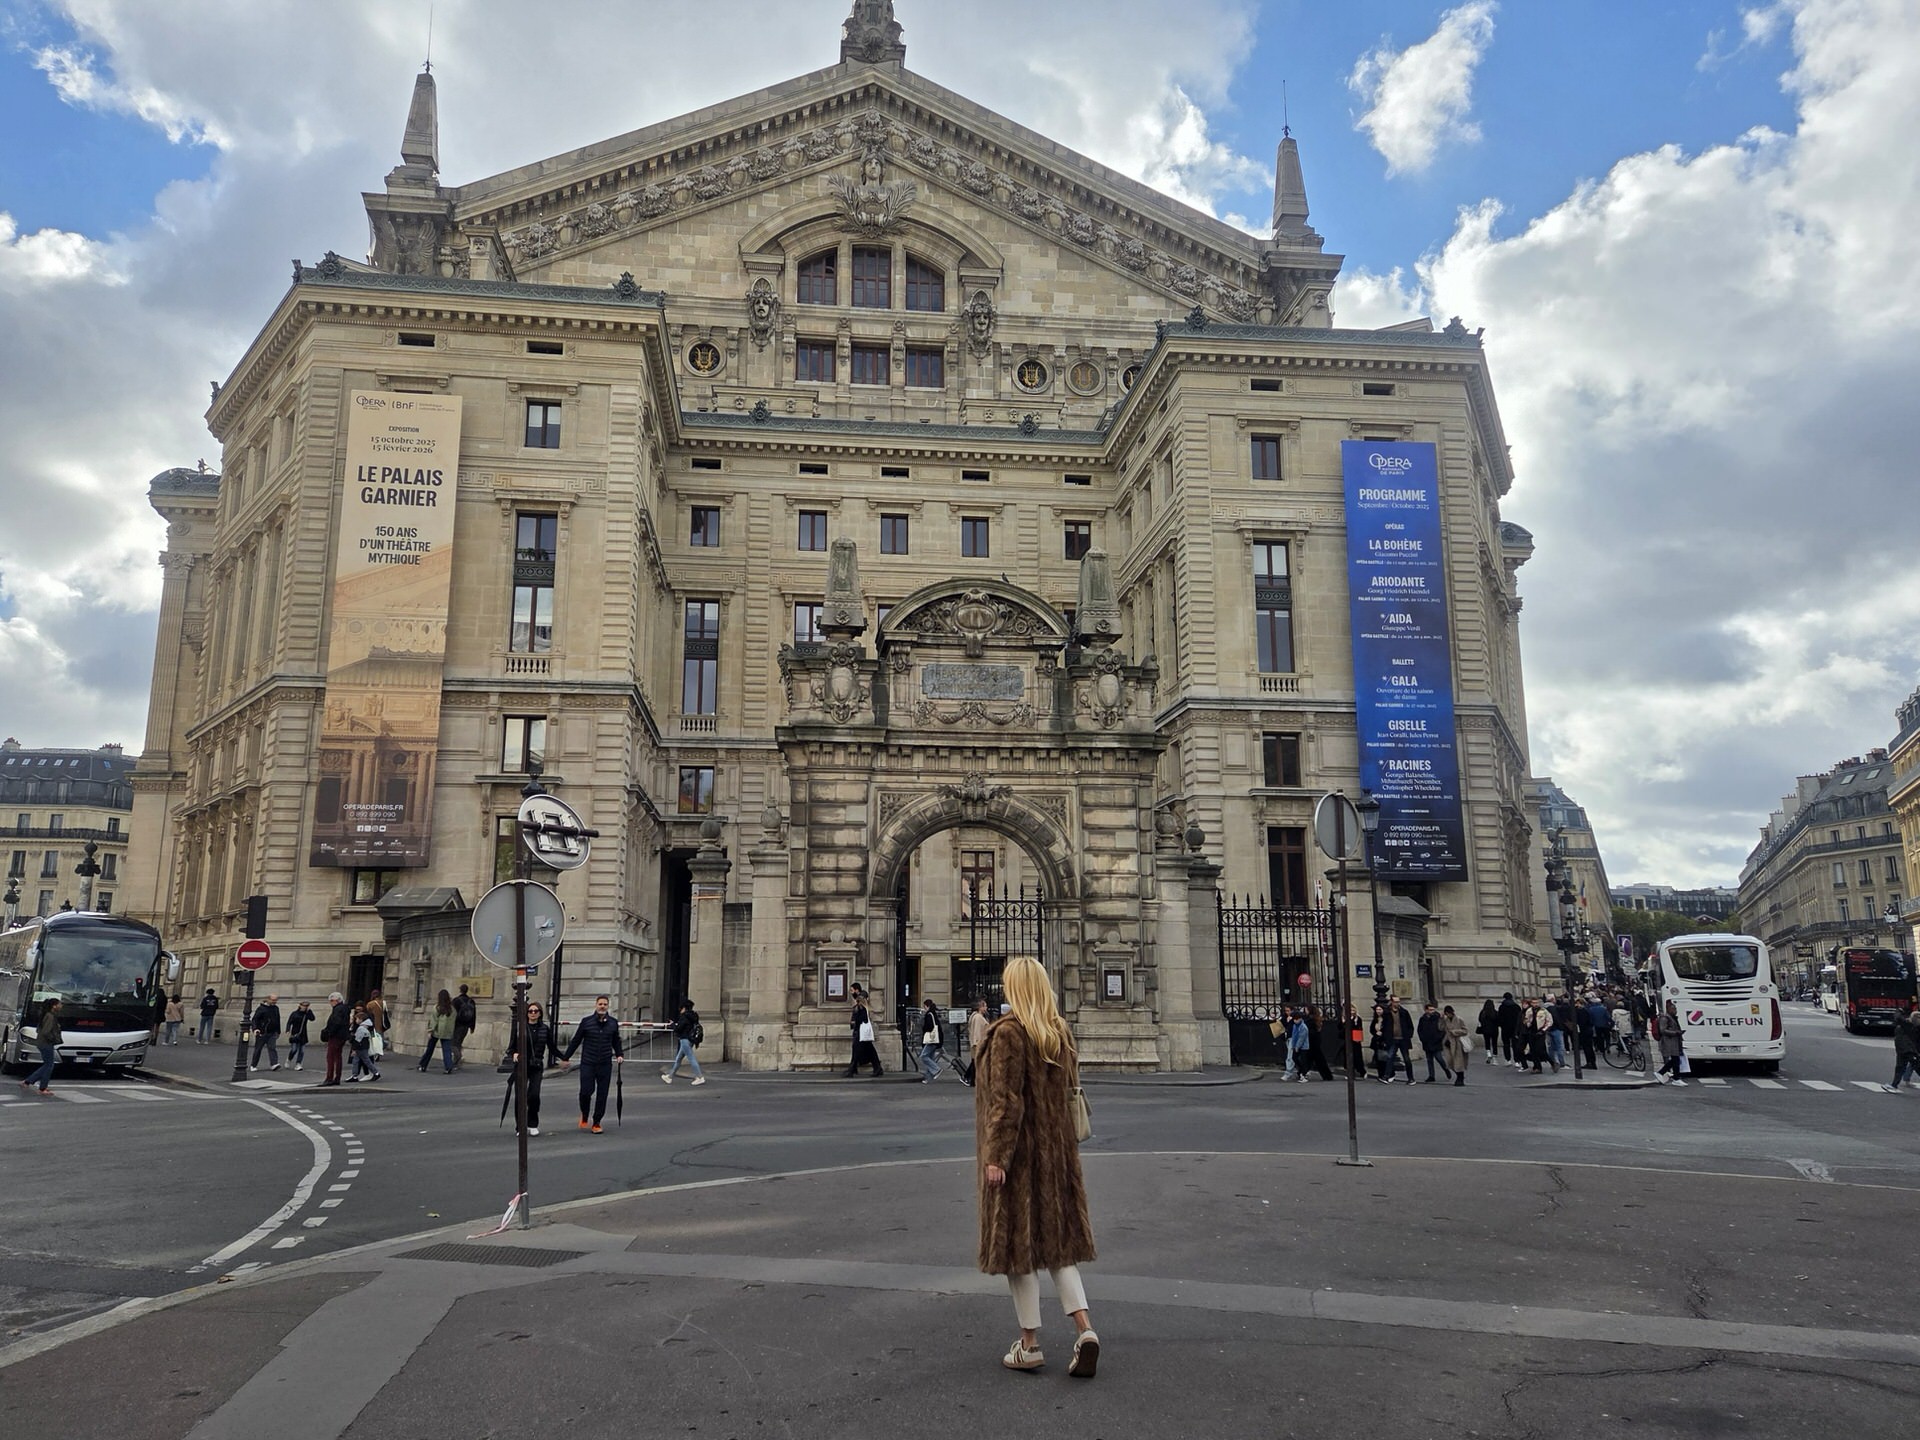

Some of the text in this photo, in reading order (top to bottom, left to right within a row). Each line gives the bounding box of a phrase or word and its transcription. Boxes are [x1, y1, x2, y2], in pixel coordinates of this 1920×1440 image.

[389, 425, 420, 433] EXPOSITION
[371, 436, 436, 447] 15 octobre 2025
[372, 444, 382, 452] 15
[383, 444, 411, 453] février
[358, 465, 443, 486] LE PALAIS
[361, 487, 437, 507] GARNIER
[1360, 488, 1427, 501] PROGRAMME
[375, 526, 418, 538] 150 ANS
[360, 538, 431, 552] D'UN THÉÂTRE
[1369, 538, 1423, 551] LA BOHÈME
[368, 553, 420, 565] MYTHIQUE
[1372, 576, 1425, 587] ARIODANTE
[1392, 658, 1415, 666] BALLETS
[1388, 719, 1427, 731] GISELLE
[343, 803, 404, 811] OPERADEPARIS.FR
[1706, 1017, 1763, 1026] TELEFUN
